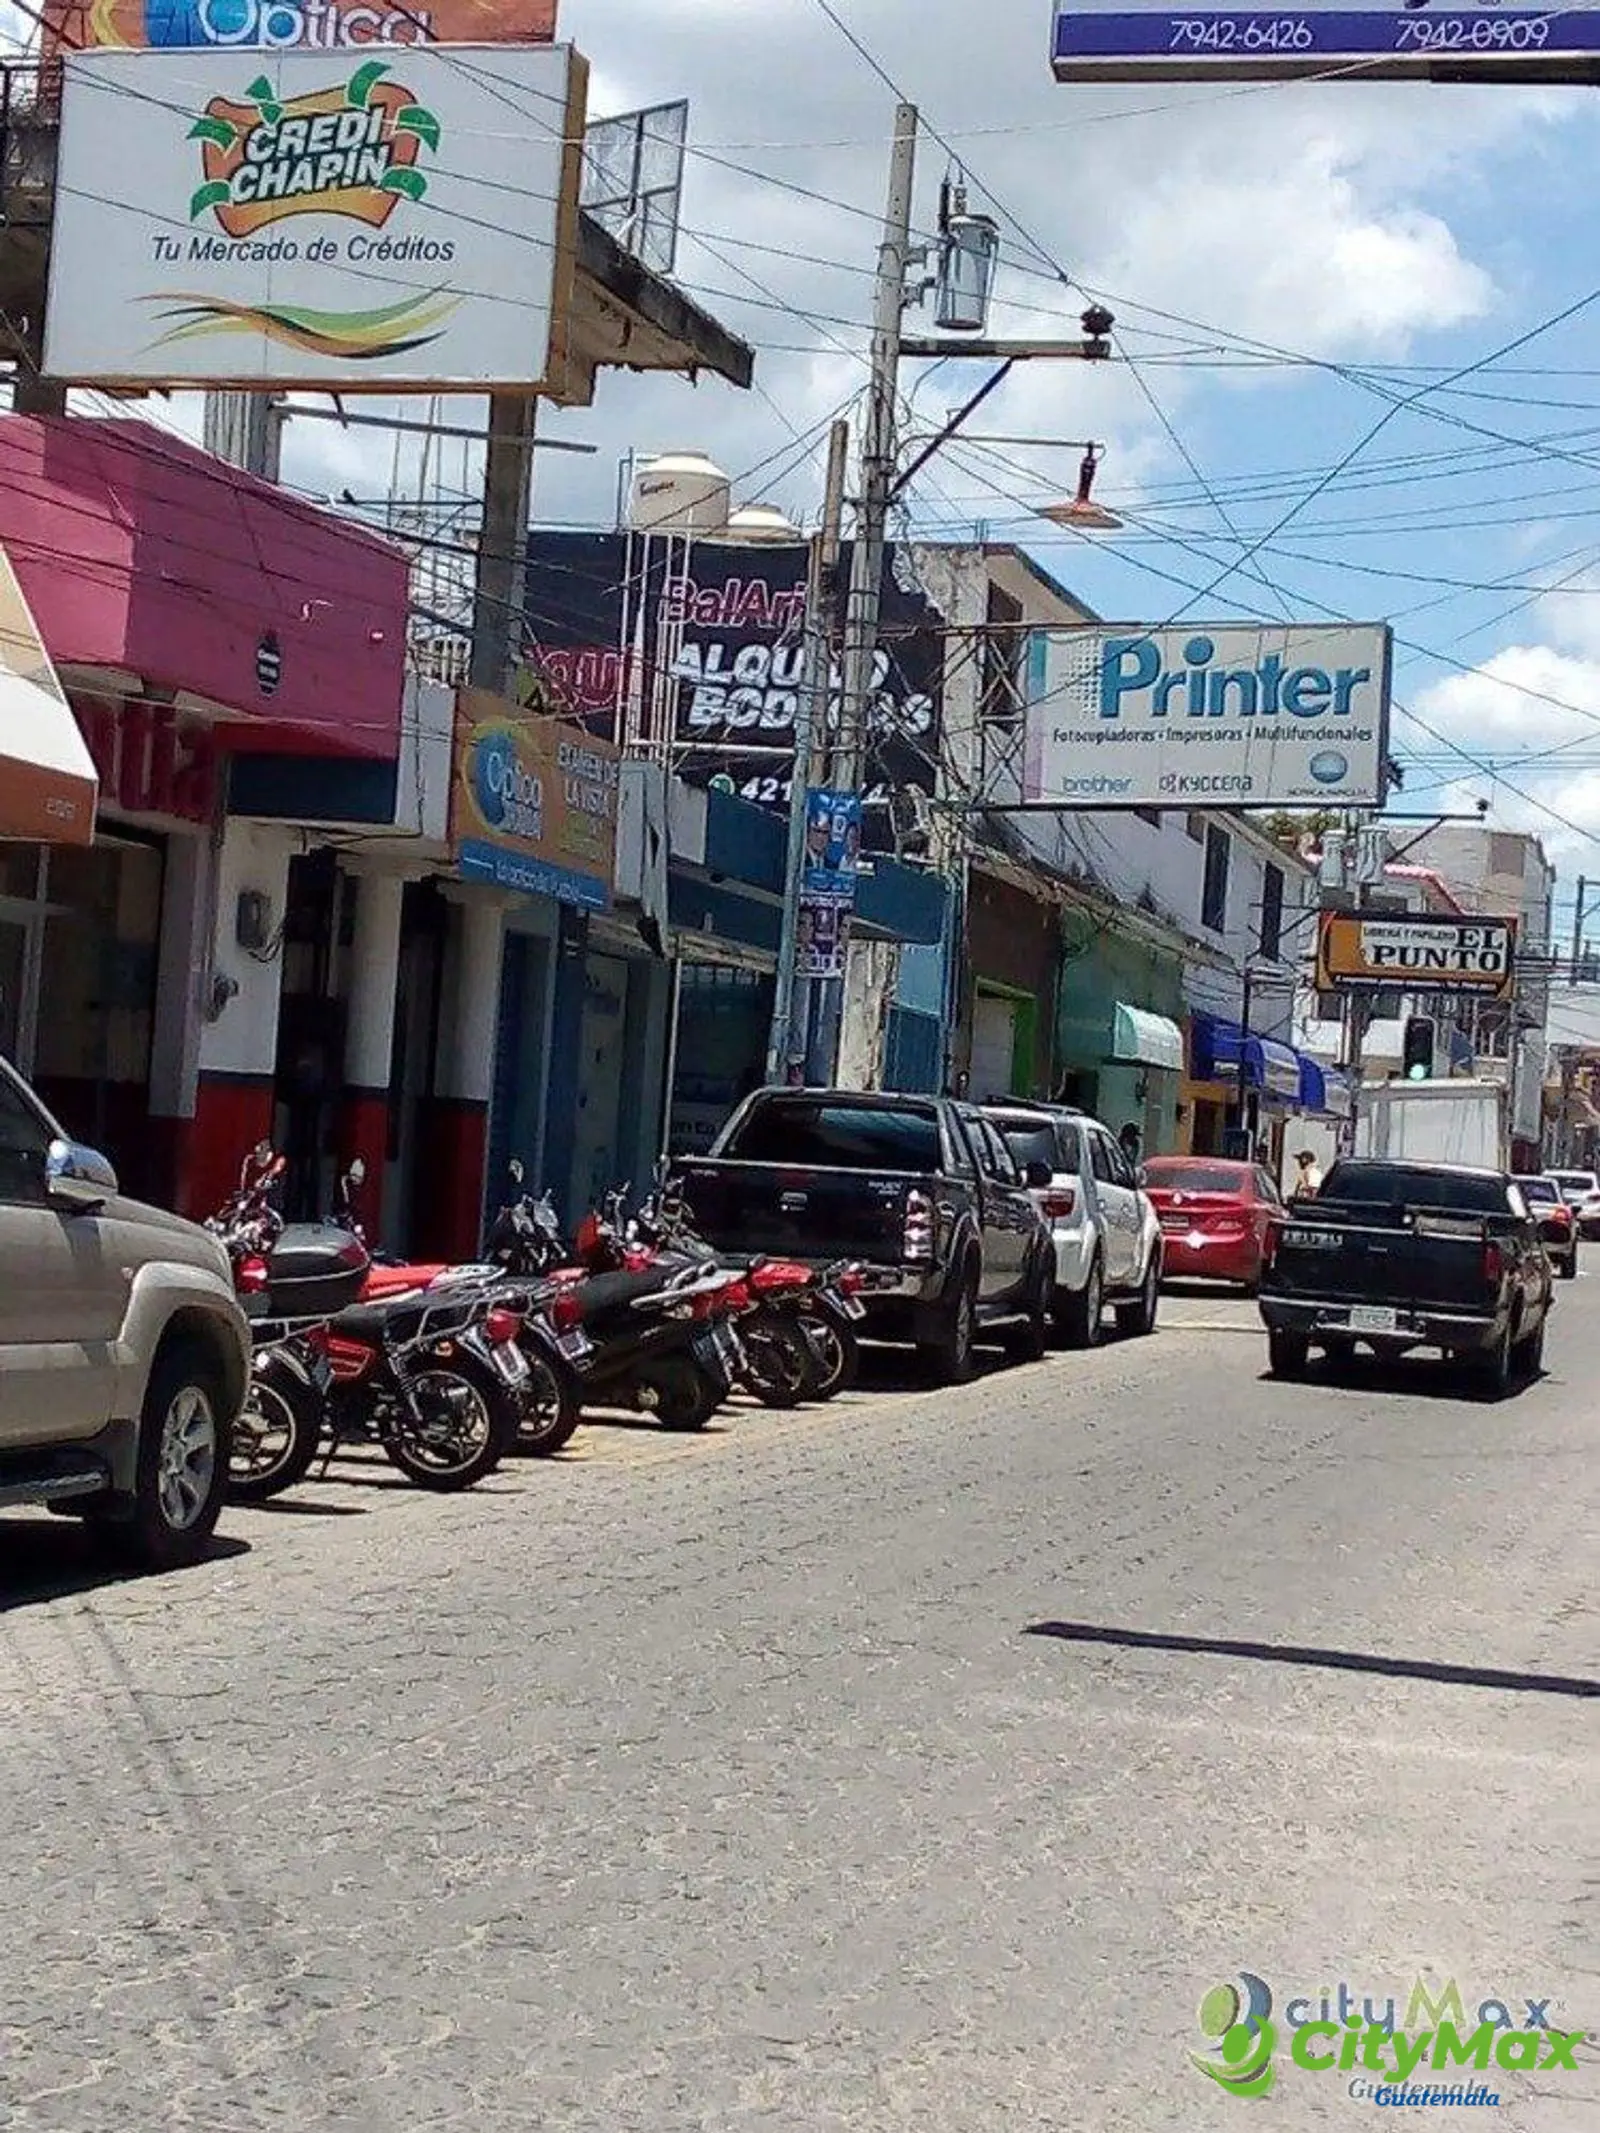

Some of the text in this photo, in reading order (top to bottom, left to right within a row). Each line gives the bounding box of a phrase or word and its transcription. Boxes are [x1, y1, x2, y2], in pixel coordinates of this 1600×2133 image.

[1169, 19, 1549, 48] 7942-6426 7942-0909
[246, 107, 383, 161] CREDI
[153, 235, 455, 261] Tu Mercado de Créditos
[1099, 637, 1371, 718] Printer
[1061, 776, 1133, 794] brother
[1457, 927, 1502, 949] EL
[1372, 944, 1500, 972] PUNTO
